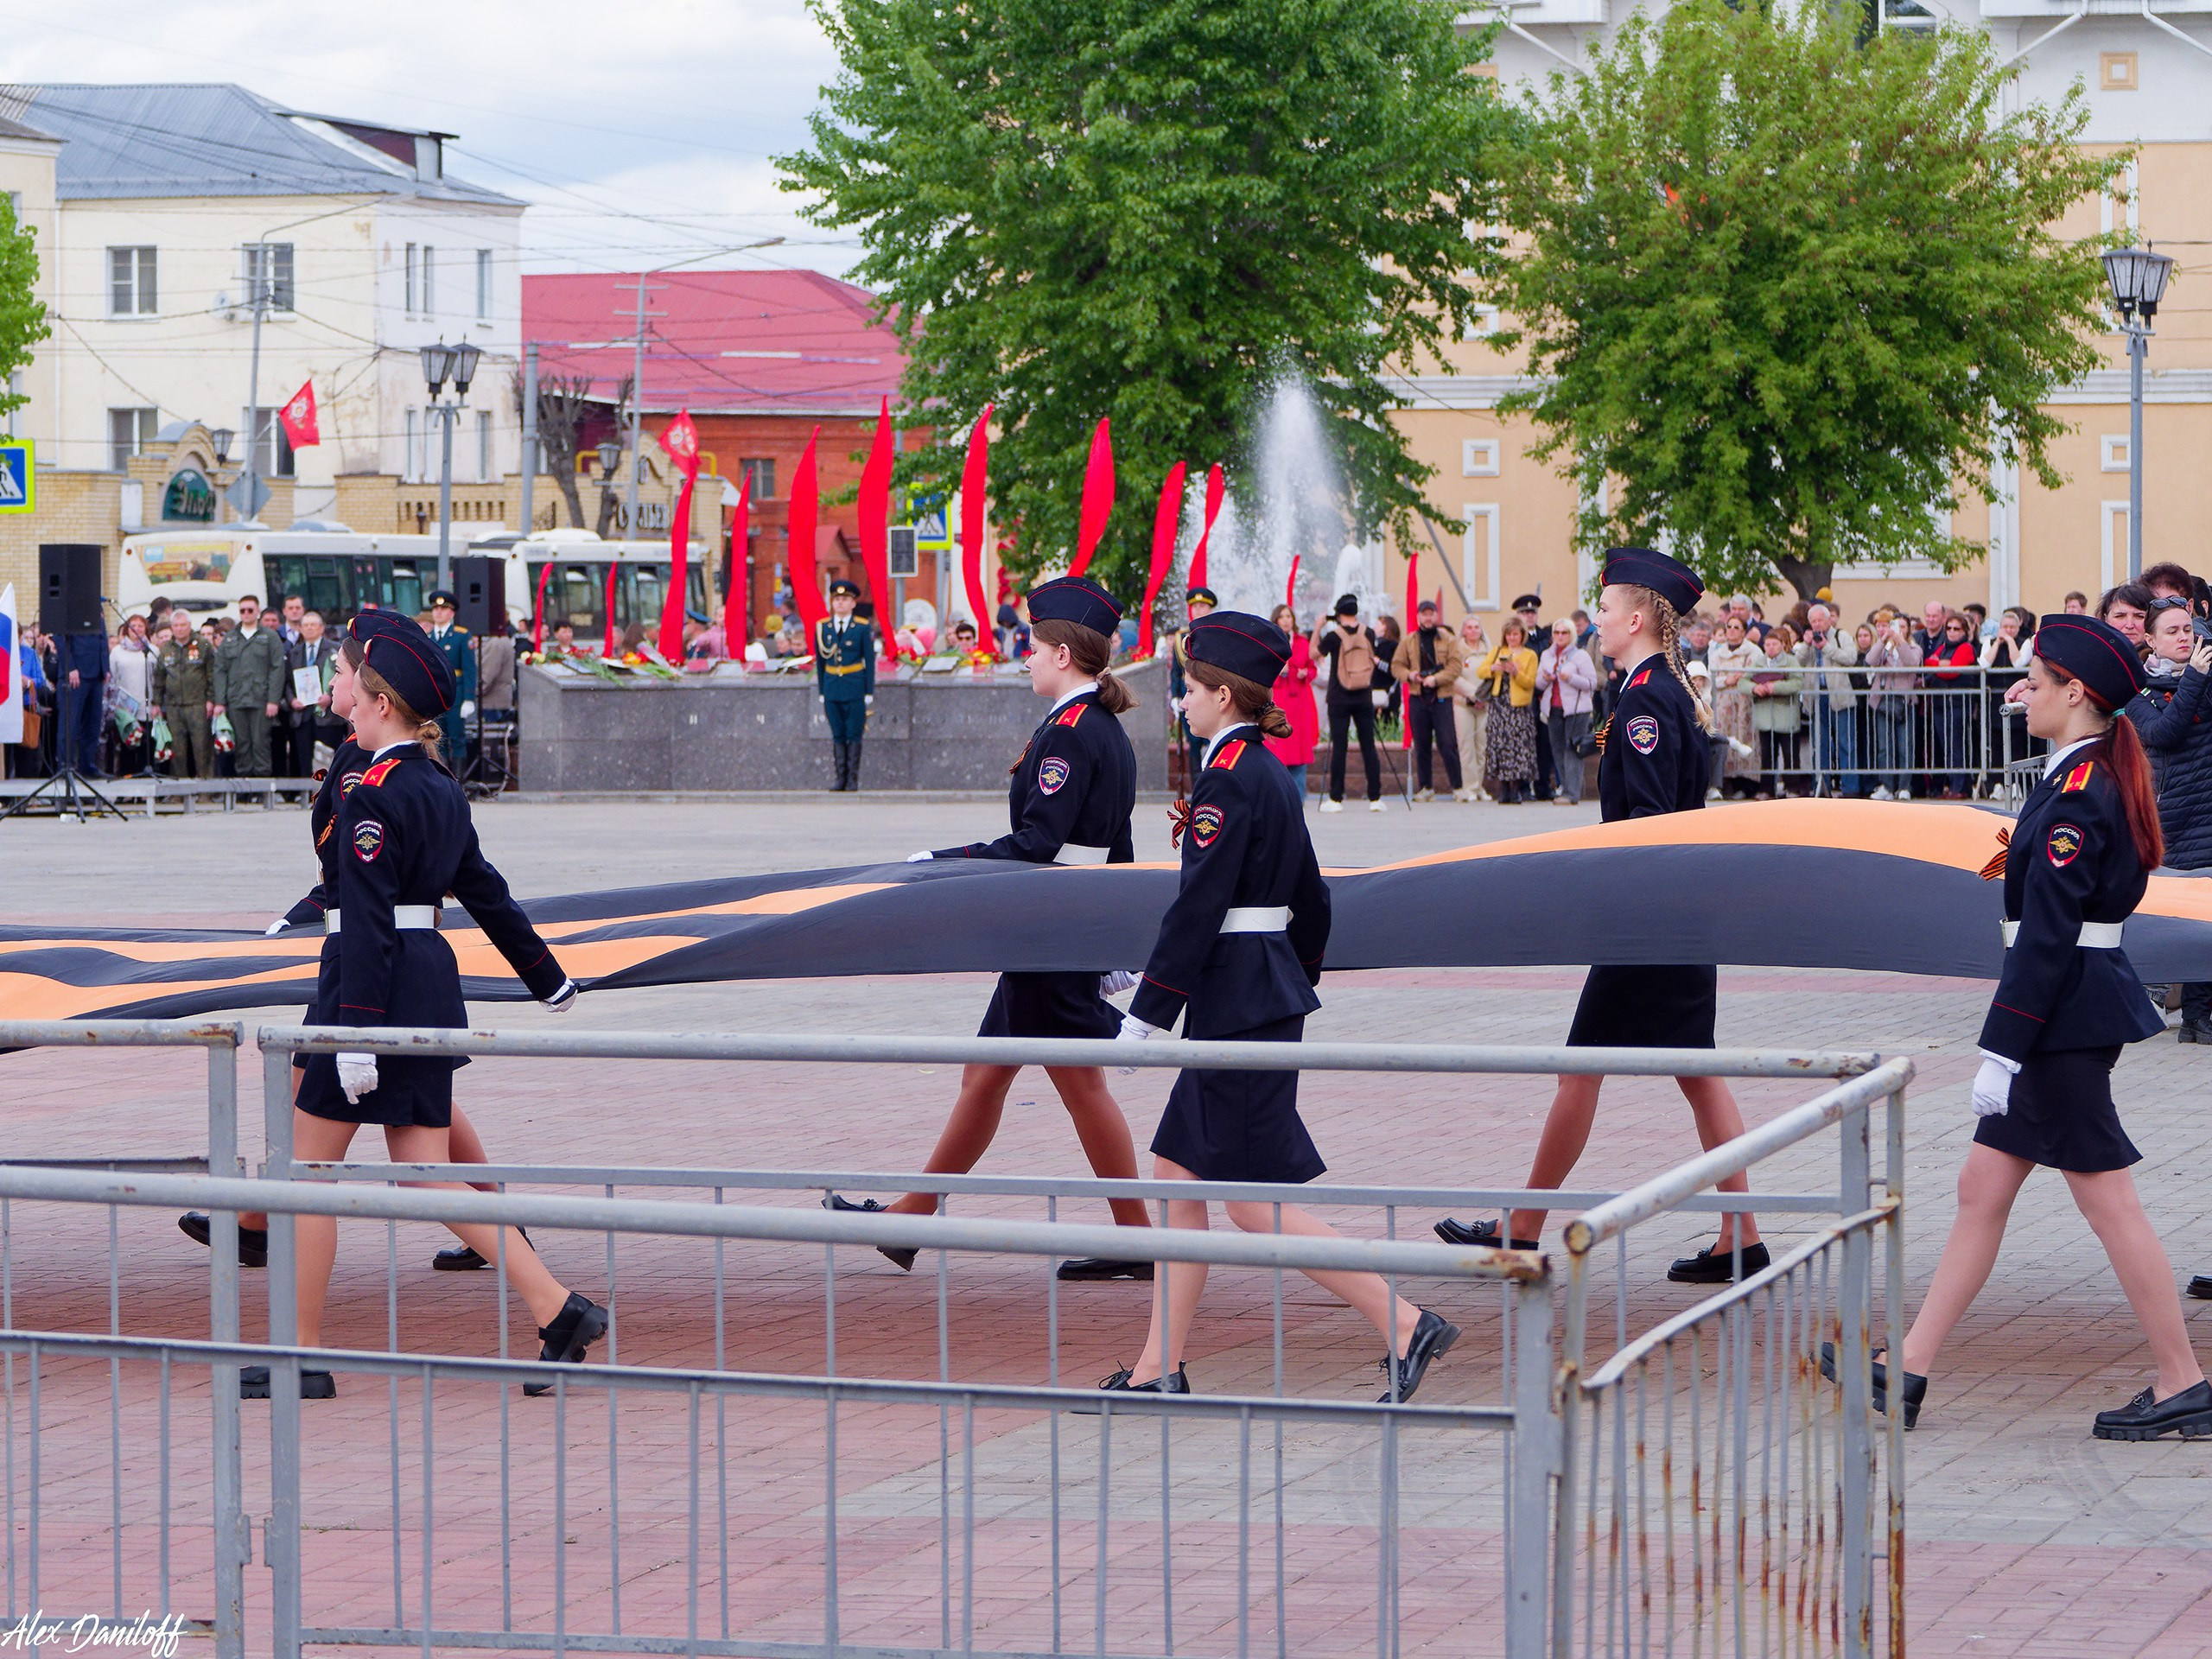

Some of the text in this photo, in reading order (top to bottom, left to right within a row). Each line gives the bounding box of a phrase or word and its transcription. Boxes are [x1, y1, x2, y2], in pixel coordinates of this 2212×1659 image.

[1194, 805, 1224, 817] ПОЛИЦИЯ
[1195, 813, 1219, 824] РОССИЯ
[356, 826, 380, 837] РОССИЯ
[2053, 827, 2081, 840] РОССИЯ
